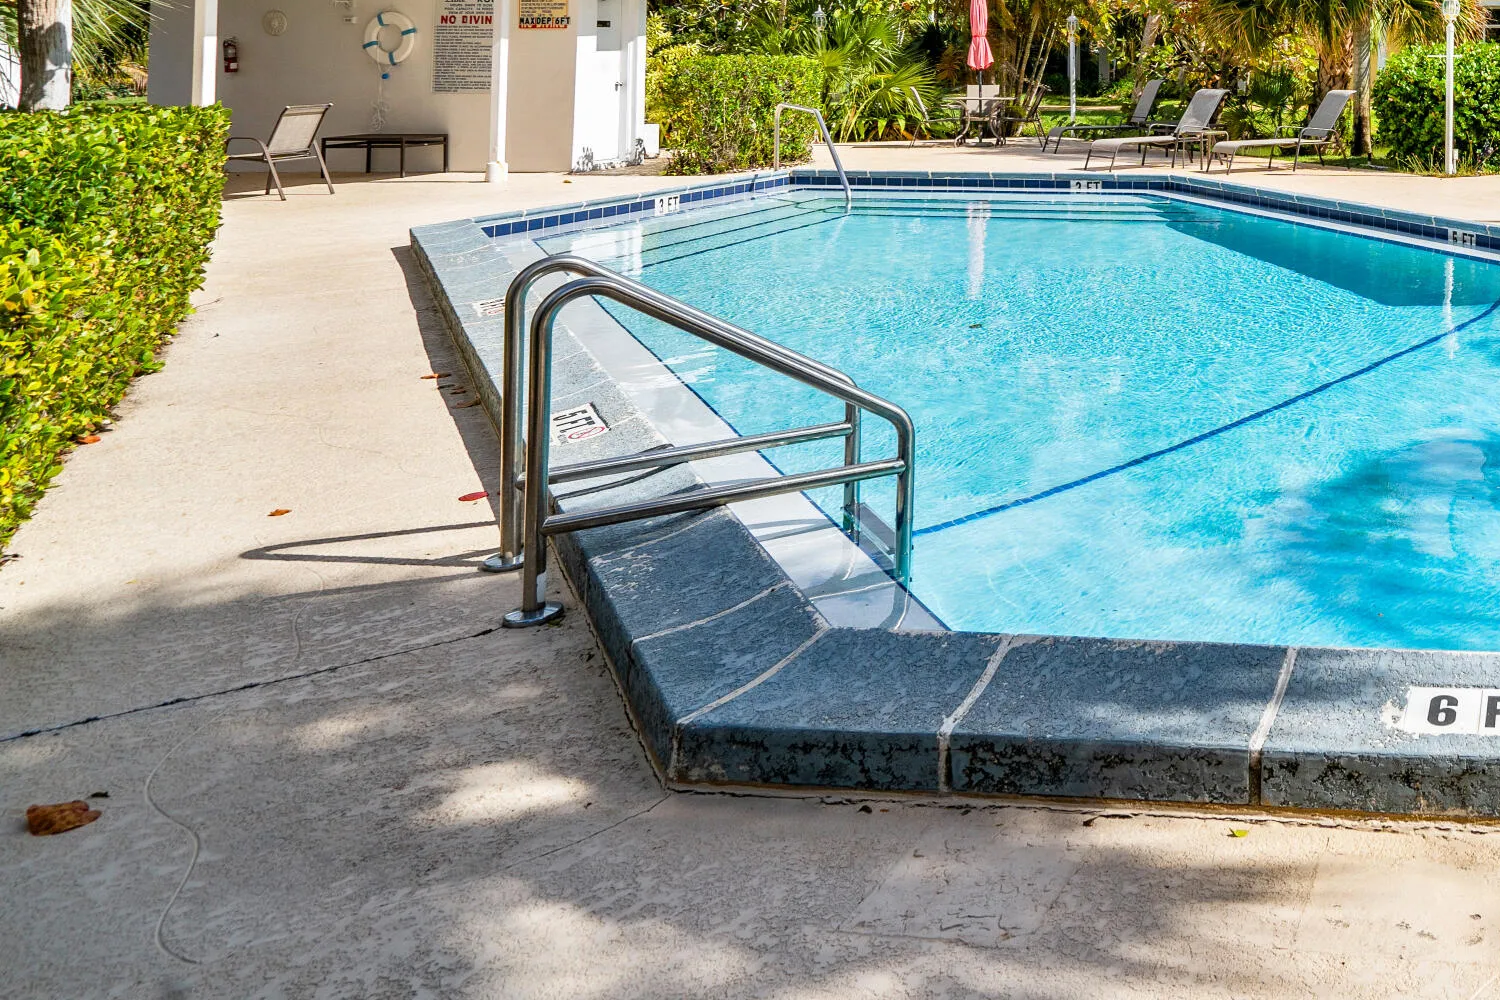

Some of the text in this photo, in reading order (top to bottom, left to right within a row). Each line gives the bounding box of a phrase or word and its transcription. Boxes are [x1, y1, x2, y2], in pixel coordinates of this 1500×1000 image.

[440, 15, 457, 24] NO
[1086, 181, 1100, 189] FT
[667, 196, 679, 210] FT
[1462, 232, 1474, 245] FT
[552, 409, 588, 421] 5
[1426, 694, 1459, 726] 6
